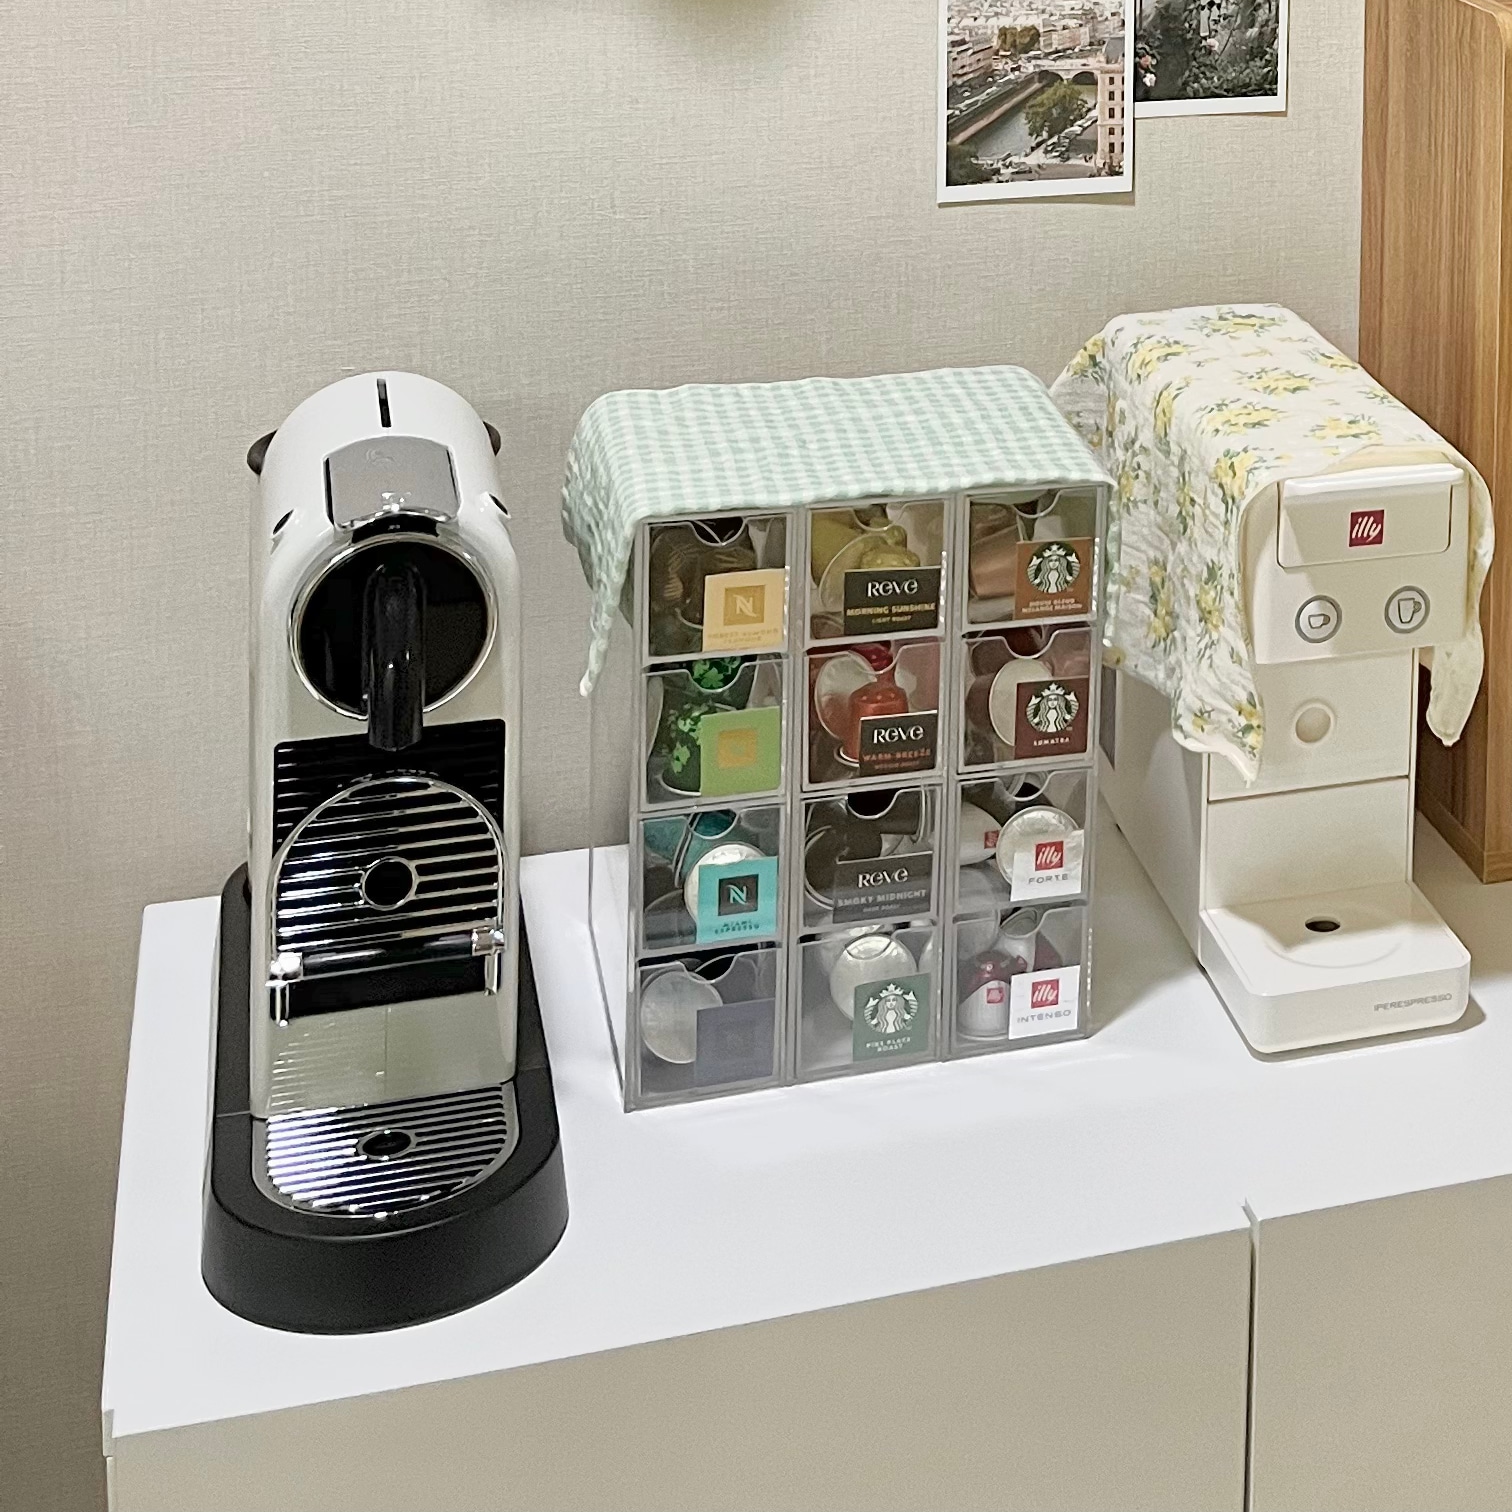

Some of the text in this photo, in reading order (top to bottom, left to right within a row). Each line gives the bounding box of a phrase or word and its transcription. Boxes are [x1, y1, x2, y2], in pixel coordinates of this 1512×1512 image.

[1351, 515, 1382, 543] illy
[1036, 845, 1062, 867] illy
[1028, 873, 1068, 885] FORTE
[837, 889, 927, 906] SMOKY MIDNIGHT
[1032, 984, 1058, 1004] illy
[1016, 1009, 1072, 1024] INTENSO
